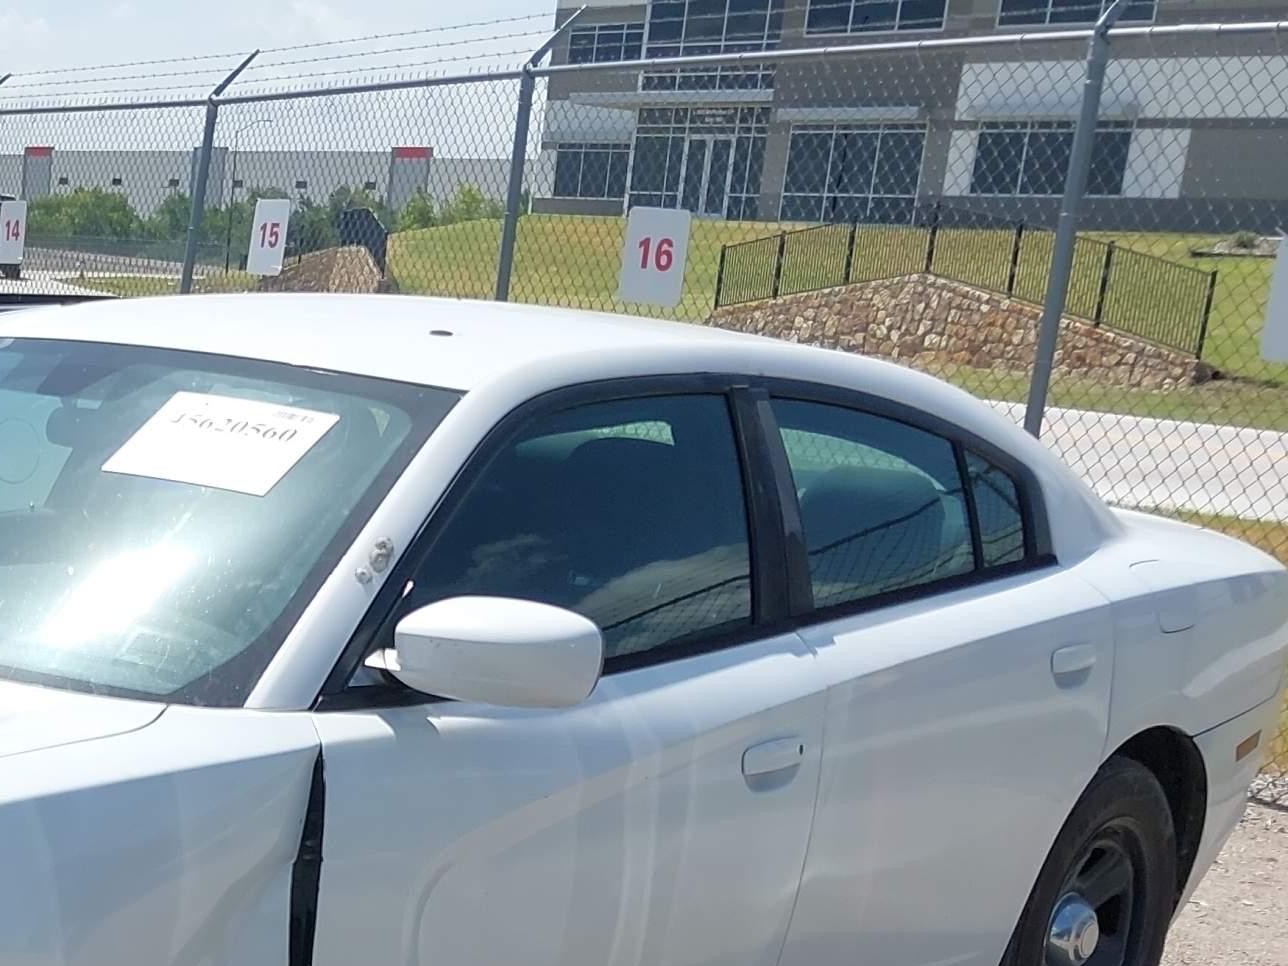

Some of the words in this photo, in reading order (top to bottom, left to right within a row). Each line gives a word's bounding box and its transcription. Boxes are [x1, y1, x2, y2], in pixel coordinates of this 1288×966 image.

[5, 219, 21, 241] 14
[260, 222, 281, 249] 15
[638, 237, 674, 272] 16
